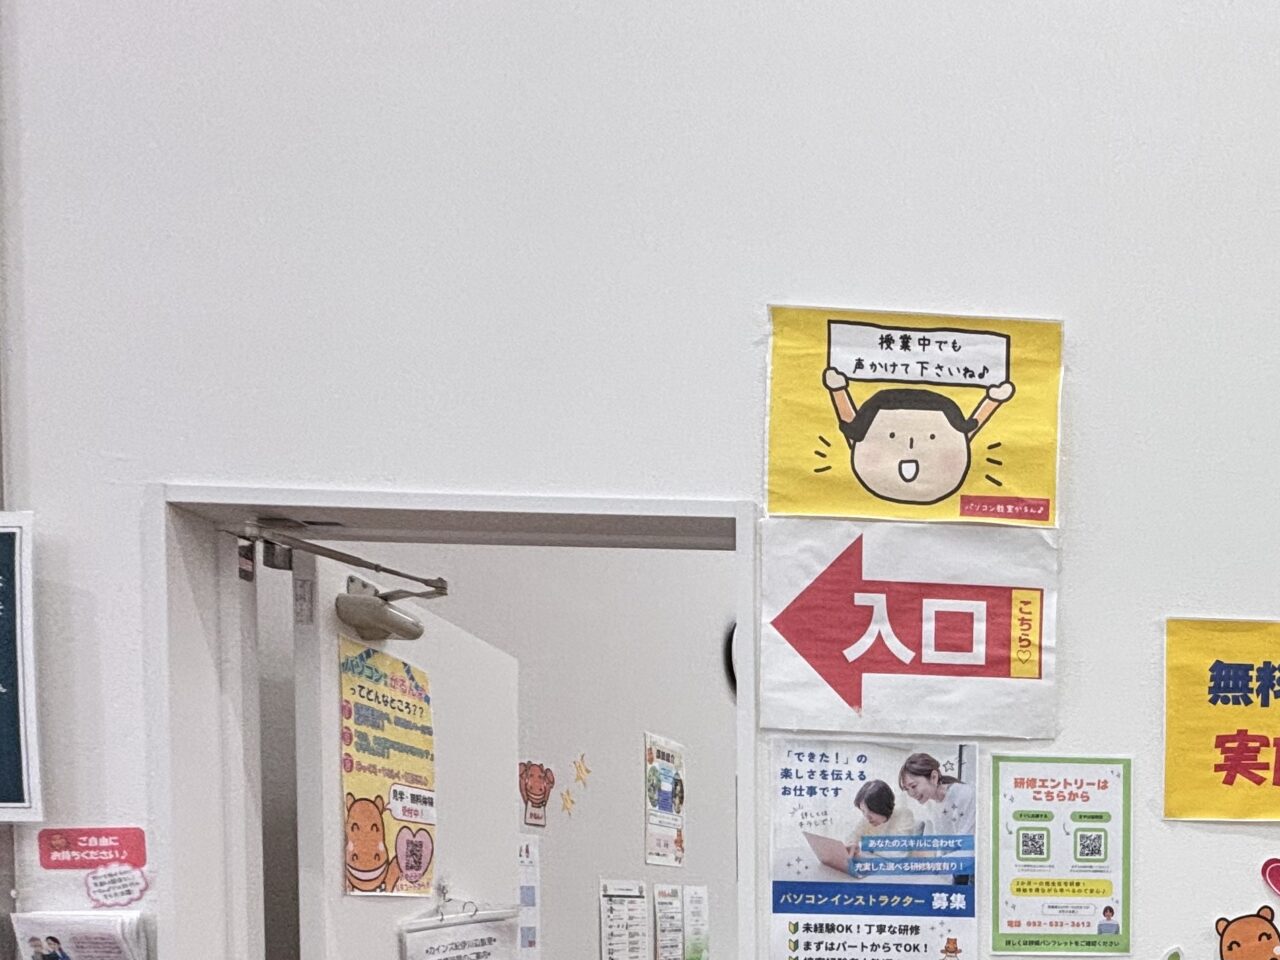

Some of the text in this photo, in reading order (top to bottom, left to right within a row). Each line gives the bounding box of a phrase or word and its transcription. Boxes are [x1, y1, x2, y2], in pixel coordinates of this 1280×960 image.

[878, 333, 962, 352] 授業中でも
[842, 591, 988, 667] 入口
[783, 750, 868, 765] 「できた！」の
[780, 768, 867, 781] 楽しさを伝える
[1013, 777, 1109, 791] 研修エントリーは
[781, 785, 843, 798] お仕事です
[1032, 790, 1090, 803] こちらから
[868, 839, 963, 849] あなたのスキルに合わせて
[780, 892, 967, 910] パソコンインストラクター 募集
[802, 922, 921, 937] 未経験OK！丁寧な研修
[803, 940, 929, 954] まずはパートからでOK！
